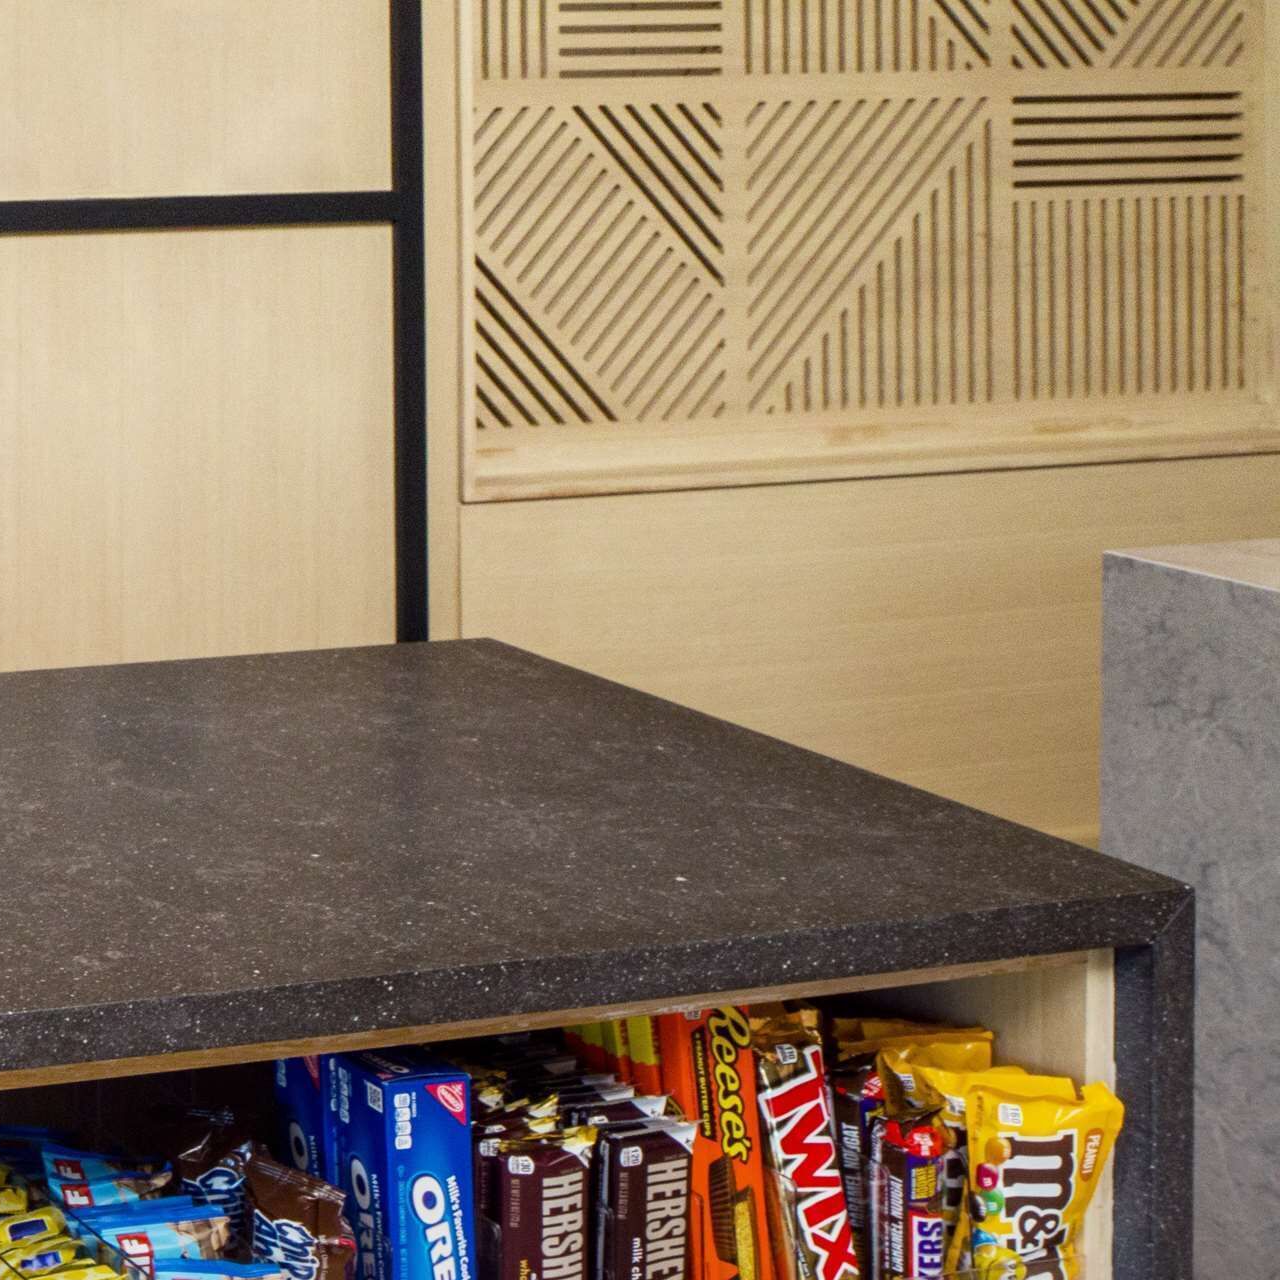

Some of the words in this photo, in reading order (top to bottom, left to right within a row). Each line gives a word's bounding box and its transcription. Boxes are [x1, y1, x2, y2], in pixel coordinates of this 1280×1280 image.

[708, 1006, 752, 1164] Reese's
[1082, 1134, 1102, 1175] PEANUT
[453, 1209, 467, 1251] Favorite
